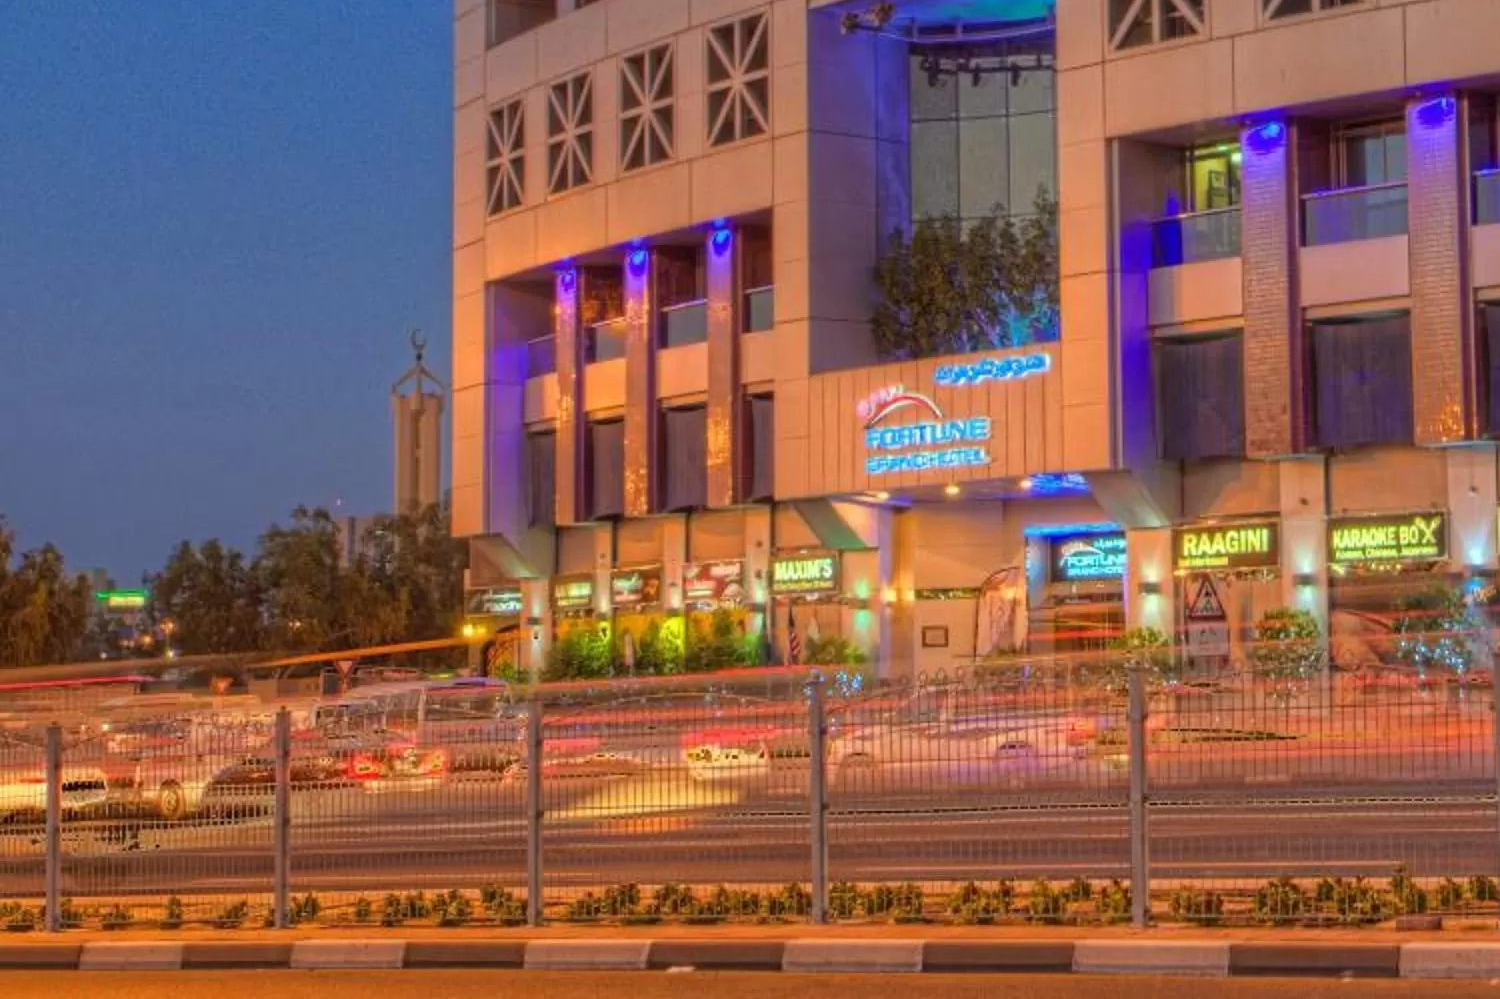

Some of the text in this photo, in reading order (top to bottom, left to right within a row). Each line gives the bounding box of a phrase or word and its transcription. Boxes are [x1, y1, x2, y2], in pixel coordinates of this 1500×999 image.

[865, 416, 991, 449] FORTUNE
[1183, 528, 1269, 556] RAAGINI
[1332, 515, 1441, 549] KARAOKE BOX
[773, 557, 833, 582] MAXIM'S
